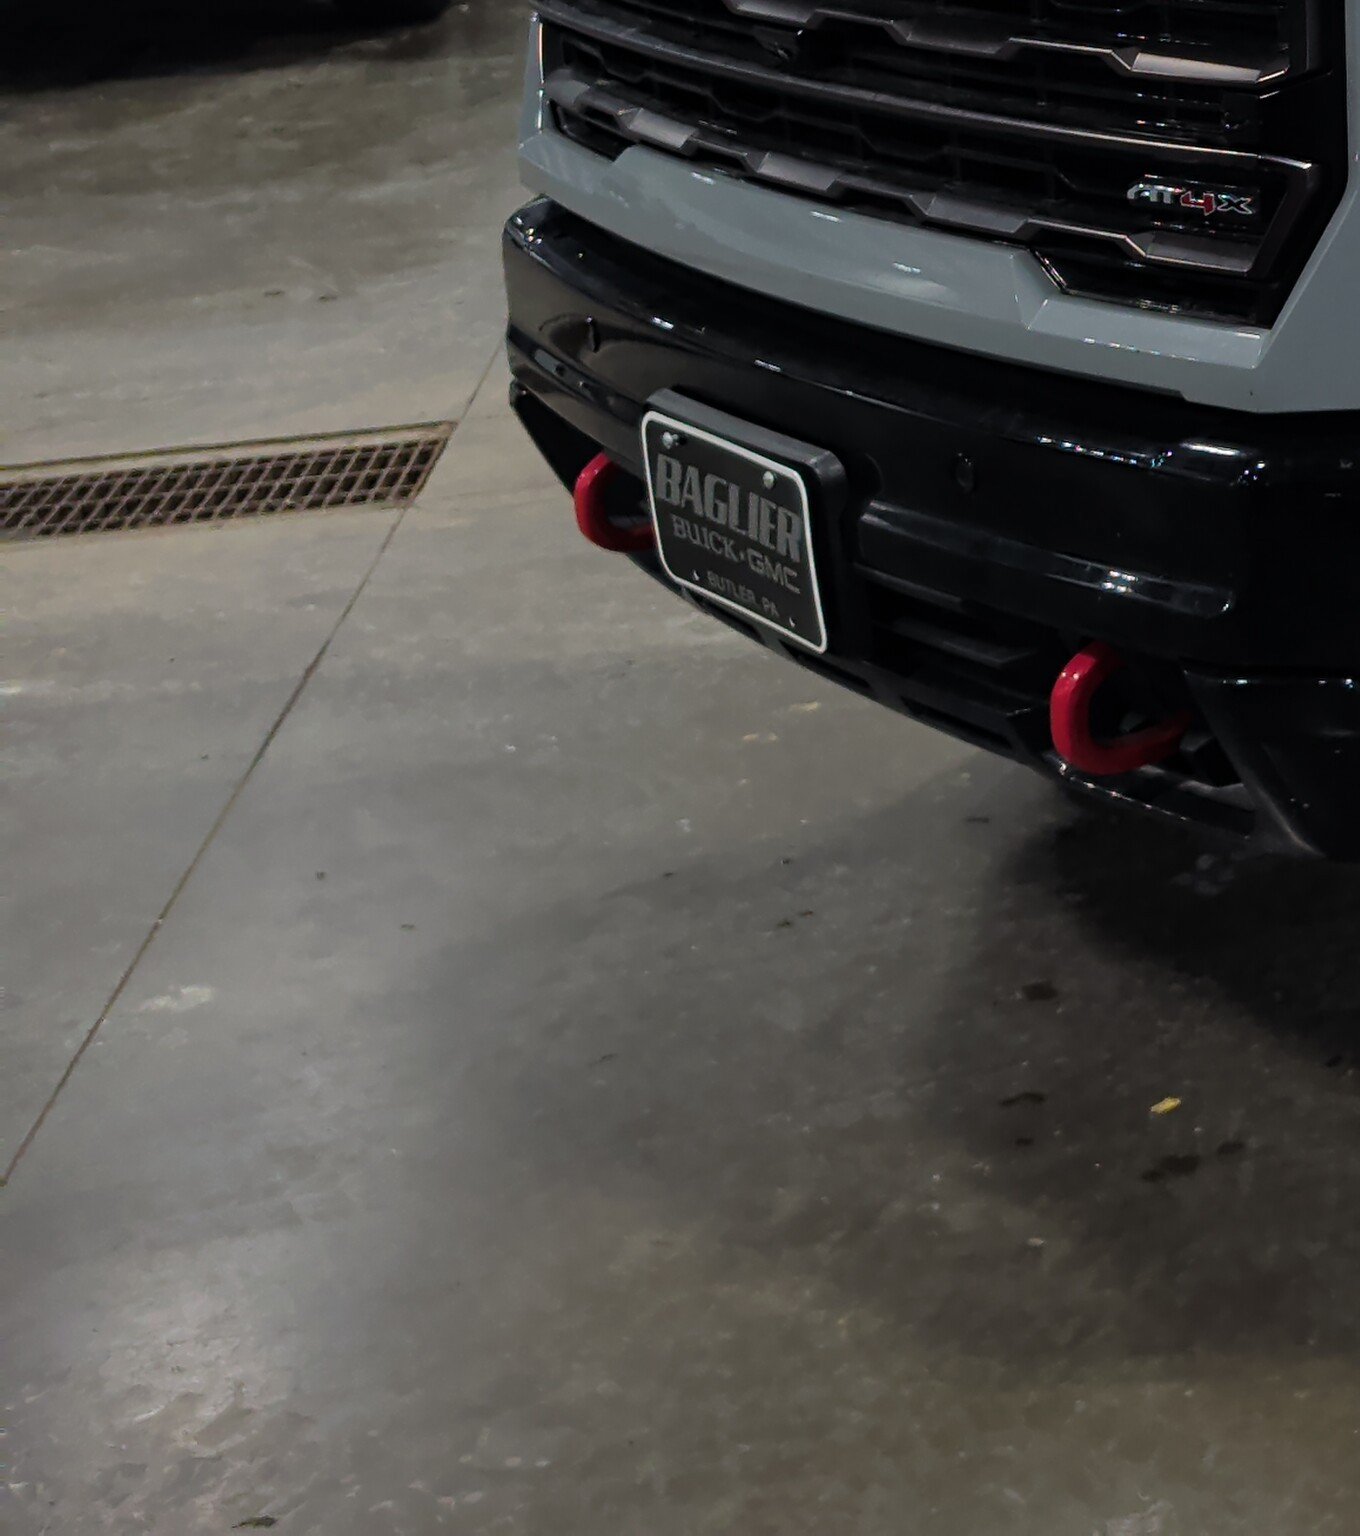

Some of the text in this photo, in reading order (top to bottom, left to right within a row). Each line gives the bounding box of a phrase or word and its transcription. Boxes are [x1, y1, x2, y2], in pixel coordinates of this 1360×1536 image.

[1126, 182, 1254, 216] AT4X
[655, 452, 802, 564] BAGLIER
[671, 514, 802, 595] BUICK GMC
